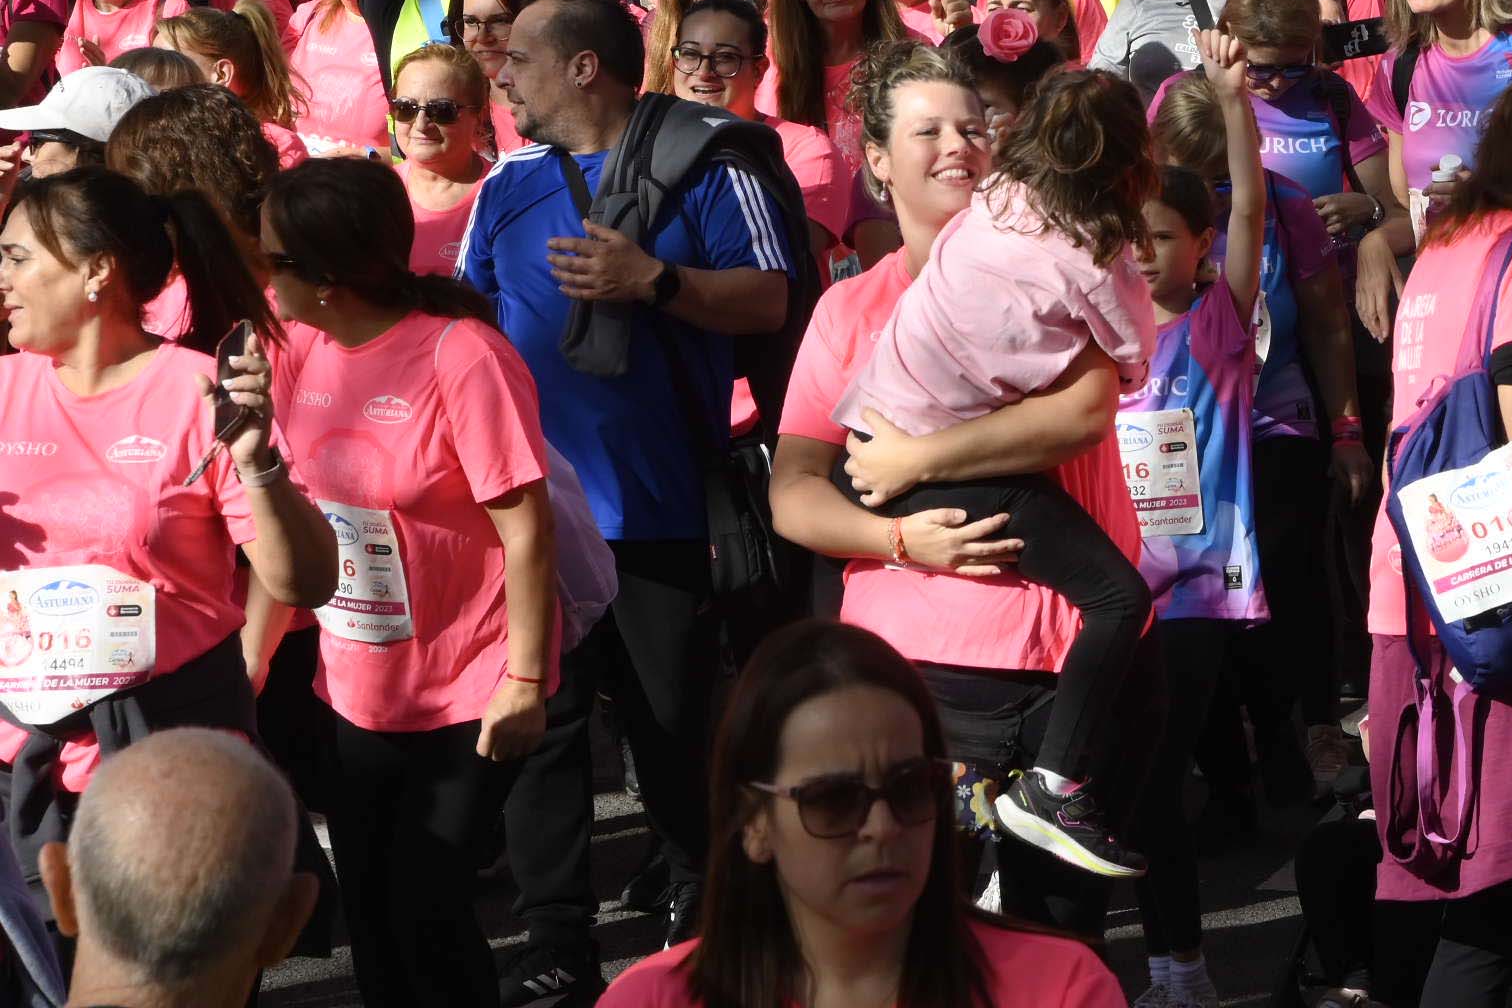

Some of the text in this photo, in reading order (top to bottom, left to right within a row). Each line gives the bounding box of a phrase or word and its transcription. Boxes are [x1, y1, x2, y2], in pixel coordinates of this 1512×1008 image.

[1158, 425, 1185, 435] SUMA
[1139, 500, 1167, 509] MUJER
[1149, 515, 1193, 527] Santander
[362, 525, 389, 536] SUMA
[342, 558, 357, 577] 6
[1450, 563, 1493, 586] CARRERA
[1494, 559, 1508, 570] DE
[106, 585, 140, 594] SUMA
[338, 599, 347, 608] LA
[347, 600, 372, 612] MUJER
[356, 619, 401, 633] Santander
[74, 677, 109, 687] MUJER
